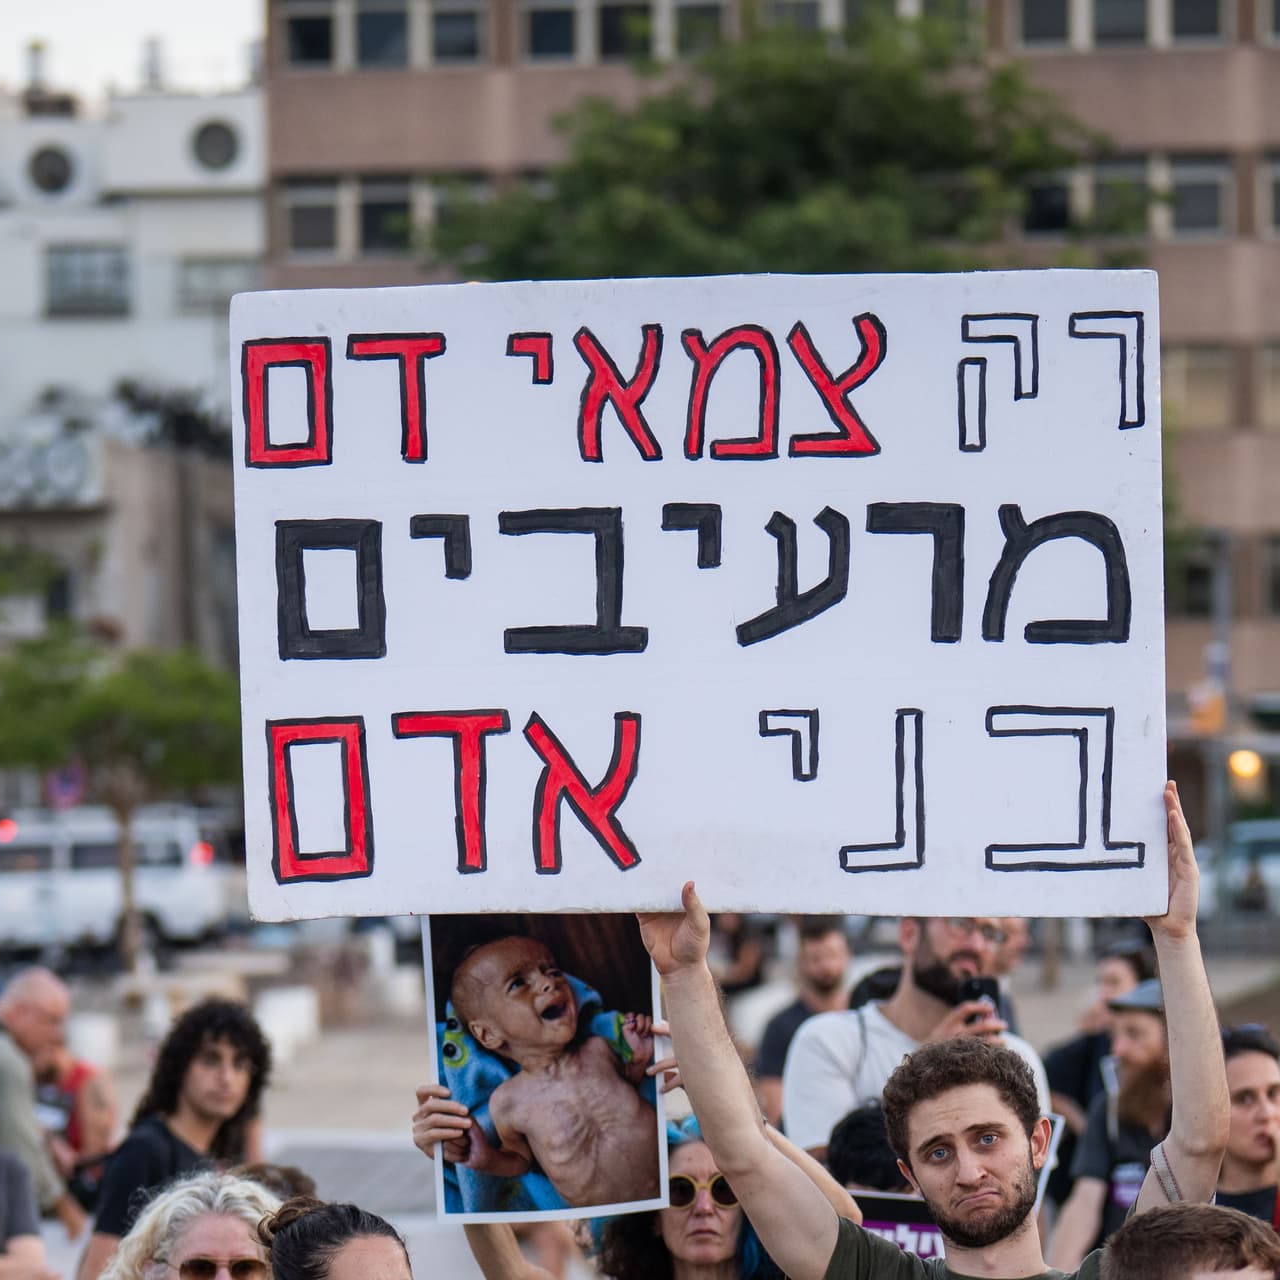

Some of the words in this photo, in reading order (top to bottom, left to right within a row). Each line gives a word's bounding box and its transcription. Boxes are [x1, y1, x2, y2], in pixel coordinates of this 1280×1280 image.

[241, 330, 447, 469] דם
[505, 311, 888, 464] צמאי
[957, 309, 1146, 453] רק
[274, 501, 1133, 661] מרעיבים
[265, 708, 642, 885] אדם
[759, 704, 1146, 873] בני
